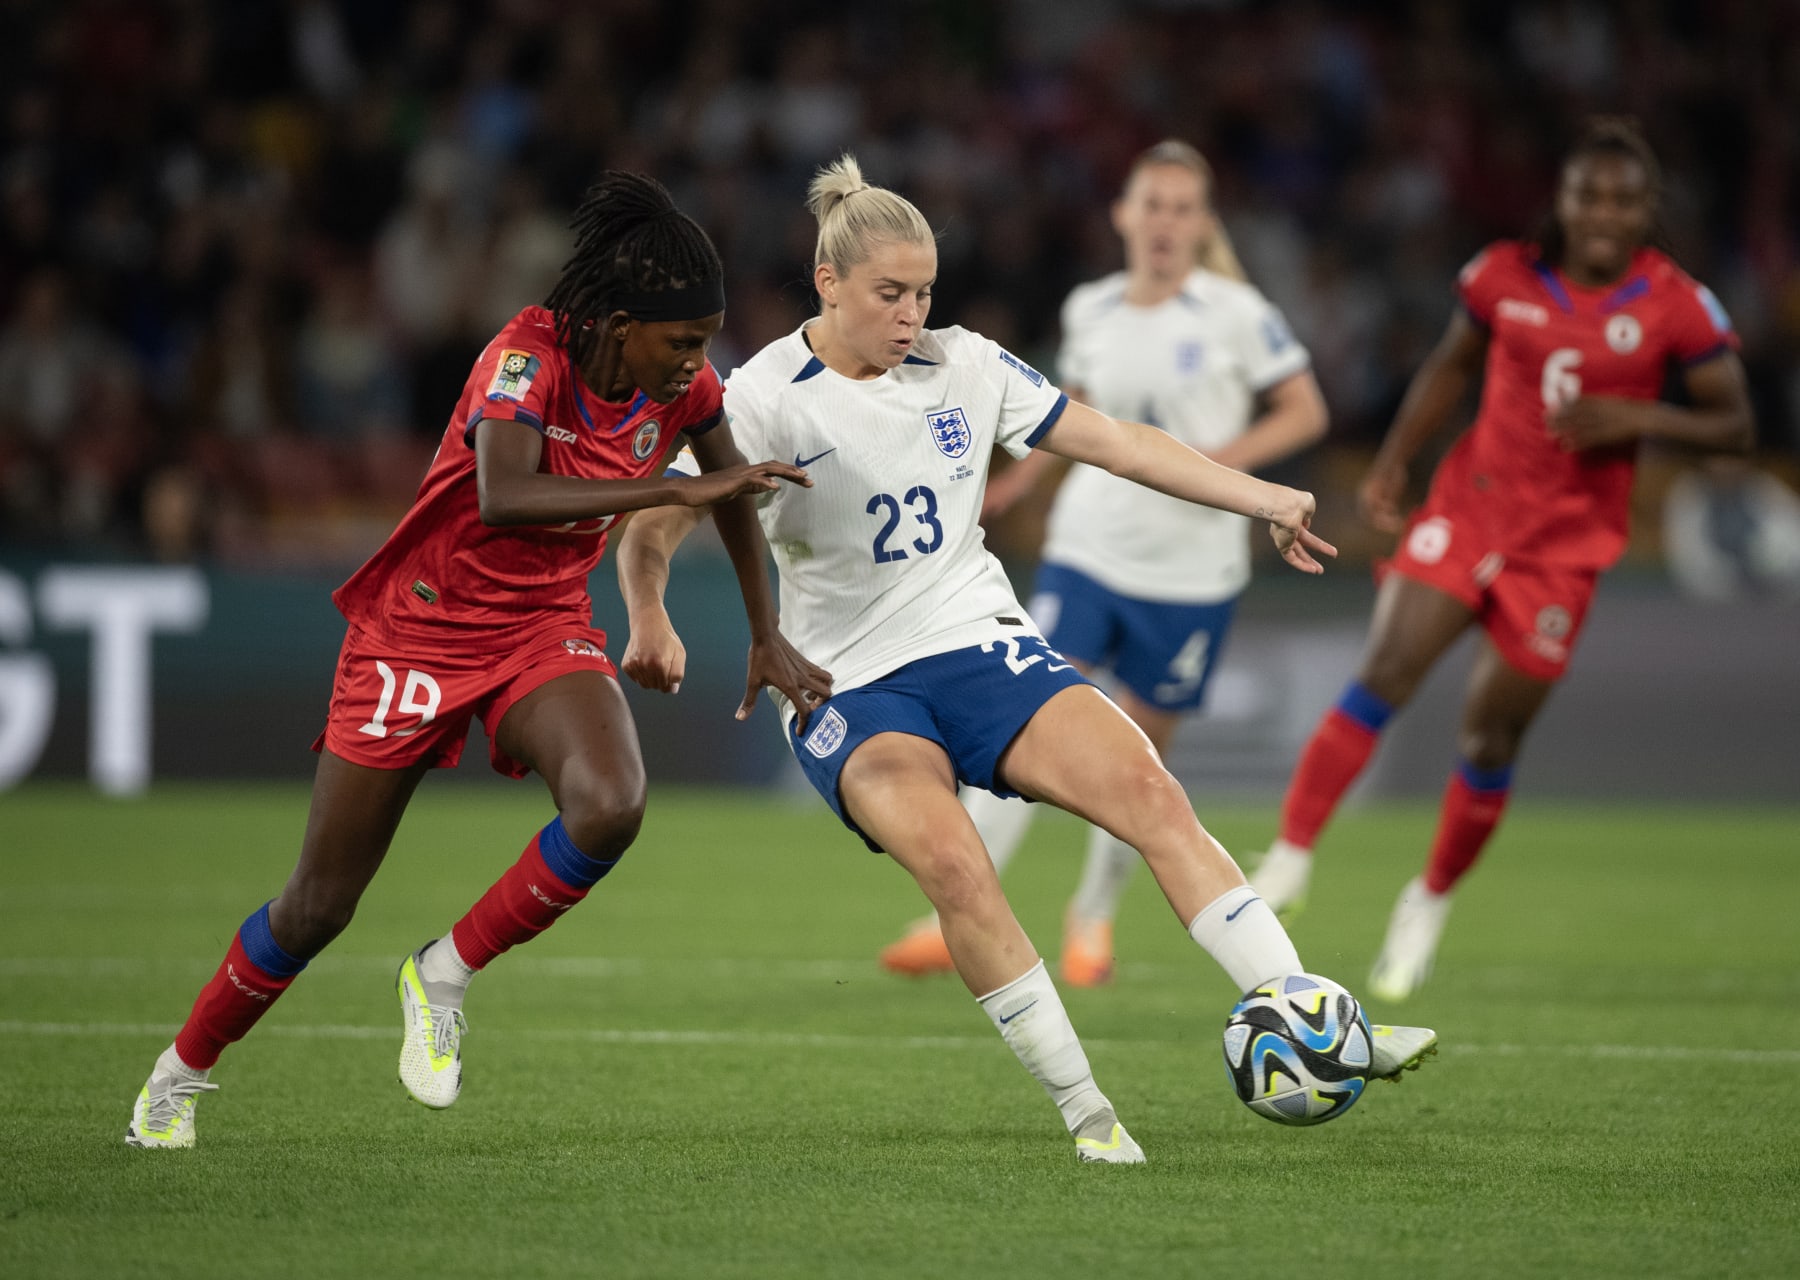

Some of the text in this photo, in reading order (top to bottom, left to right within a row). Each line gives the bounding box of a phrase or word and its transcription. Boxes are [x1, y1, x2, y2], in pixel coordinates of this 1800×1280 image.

[1541, 348, 1582, 412] 6
[865, 485, 944, 564] 23
[358, 660, 442, 738] 19
